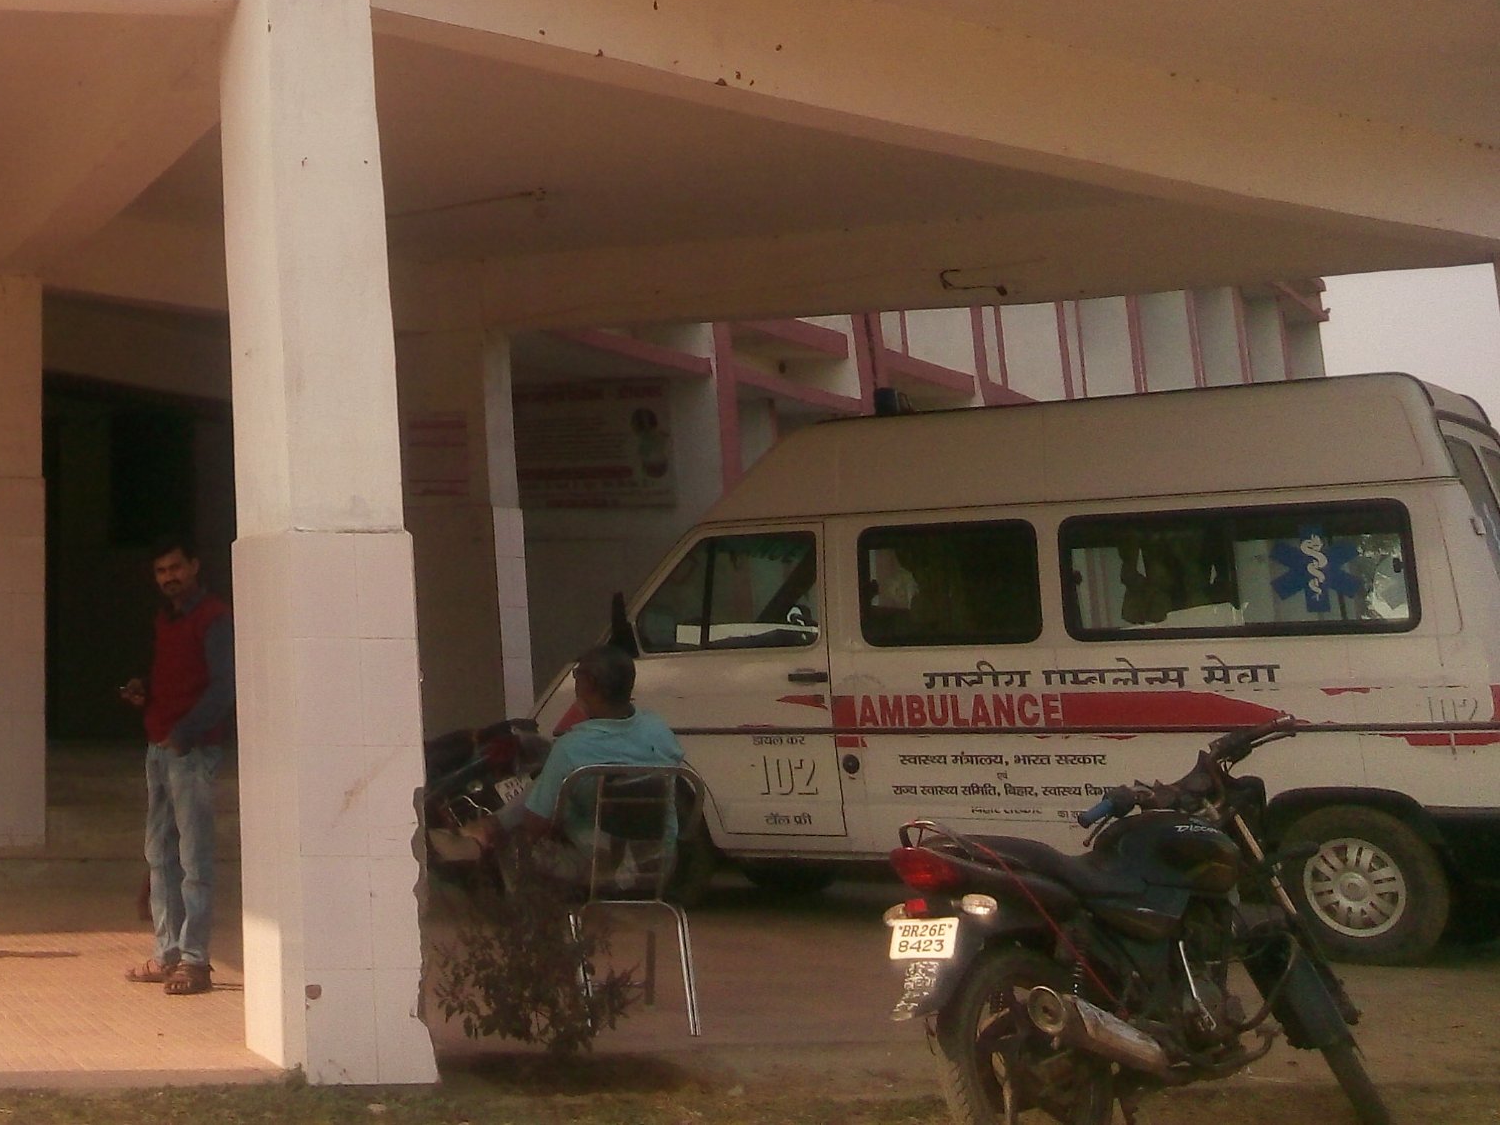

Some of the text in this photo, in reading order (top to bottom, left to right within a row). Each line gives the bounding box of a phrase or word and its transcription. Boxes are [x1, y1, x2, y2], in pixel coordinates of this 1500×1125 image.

[858, 692, 1063, 727] AMBULANCE
[899, 751, 1108, 767] स्वास्थ्य मंत्रालय, भारत सरकार
[892, 784, 918, 797] राज्य
[920, 784, 958, 797] स्वास्थ्य
[1041, 786, 1082, 796] स्वास्थ्य
[901, 923, 947, 938] BR26E
[898, 939, 945, 953] 8423
